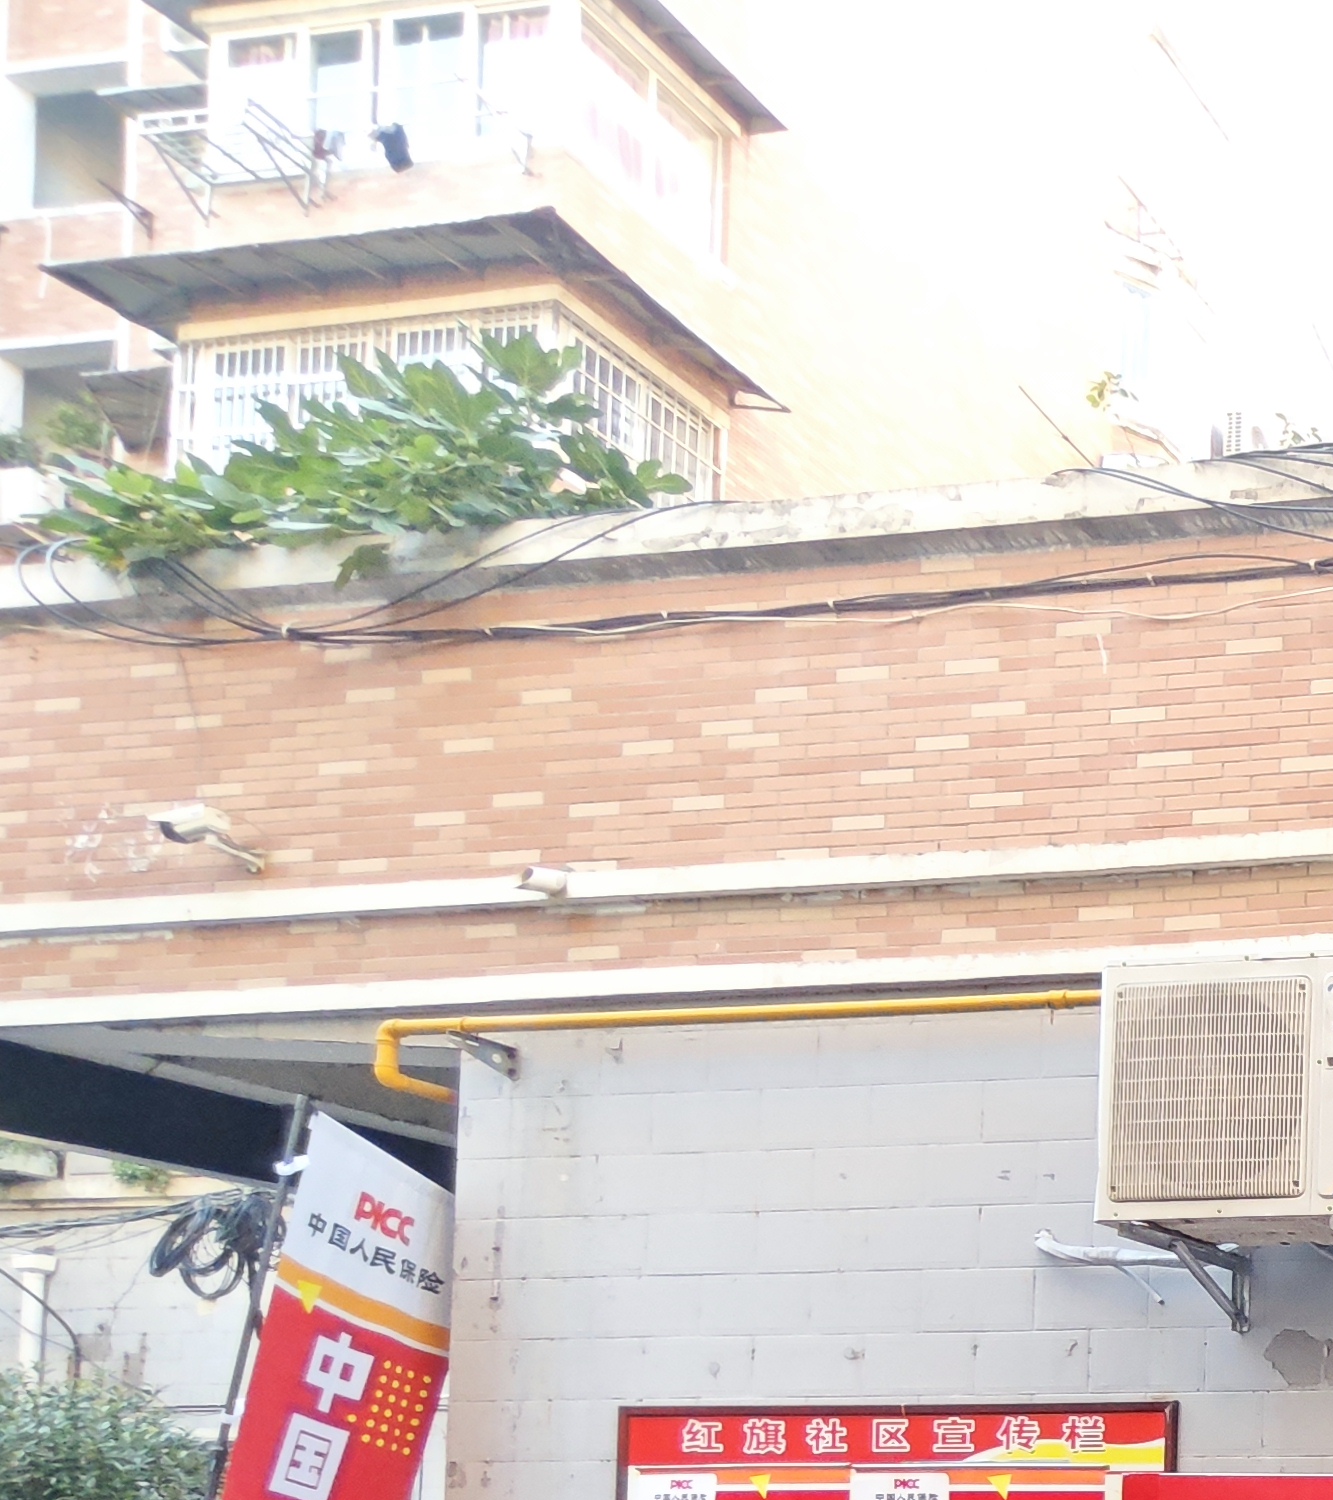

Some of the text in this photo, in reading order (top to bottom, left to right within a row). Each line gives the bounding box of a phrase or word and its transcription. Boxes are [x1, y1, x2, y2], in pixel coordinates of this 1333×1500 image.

[354, 1192, 416, 1246] PICC
[307, 1212, 445, 1295] 中国人民保险
[682, 1416, 1108, 1455] 红旗社区宣传栏
[670, 1479, 694, 1490] PICC
[894, 1479, 920, 1490] PICC
